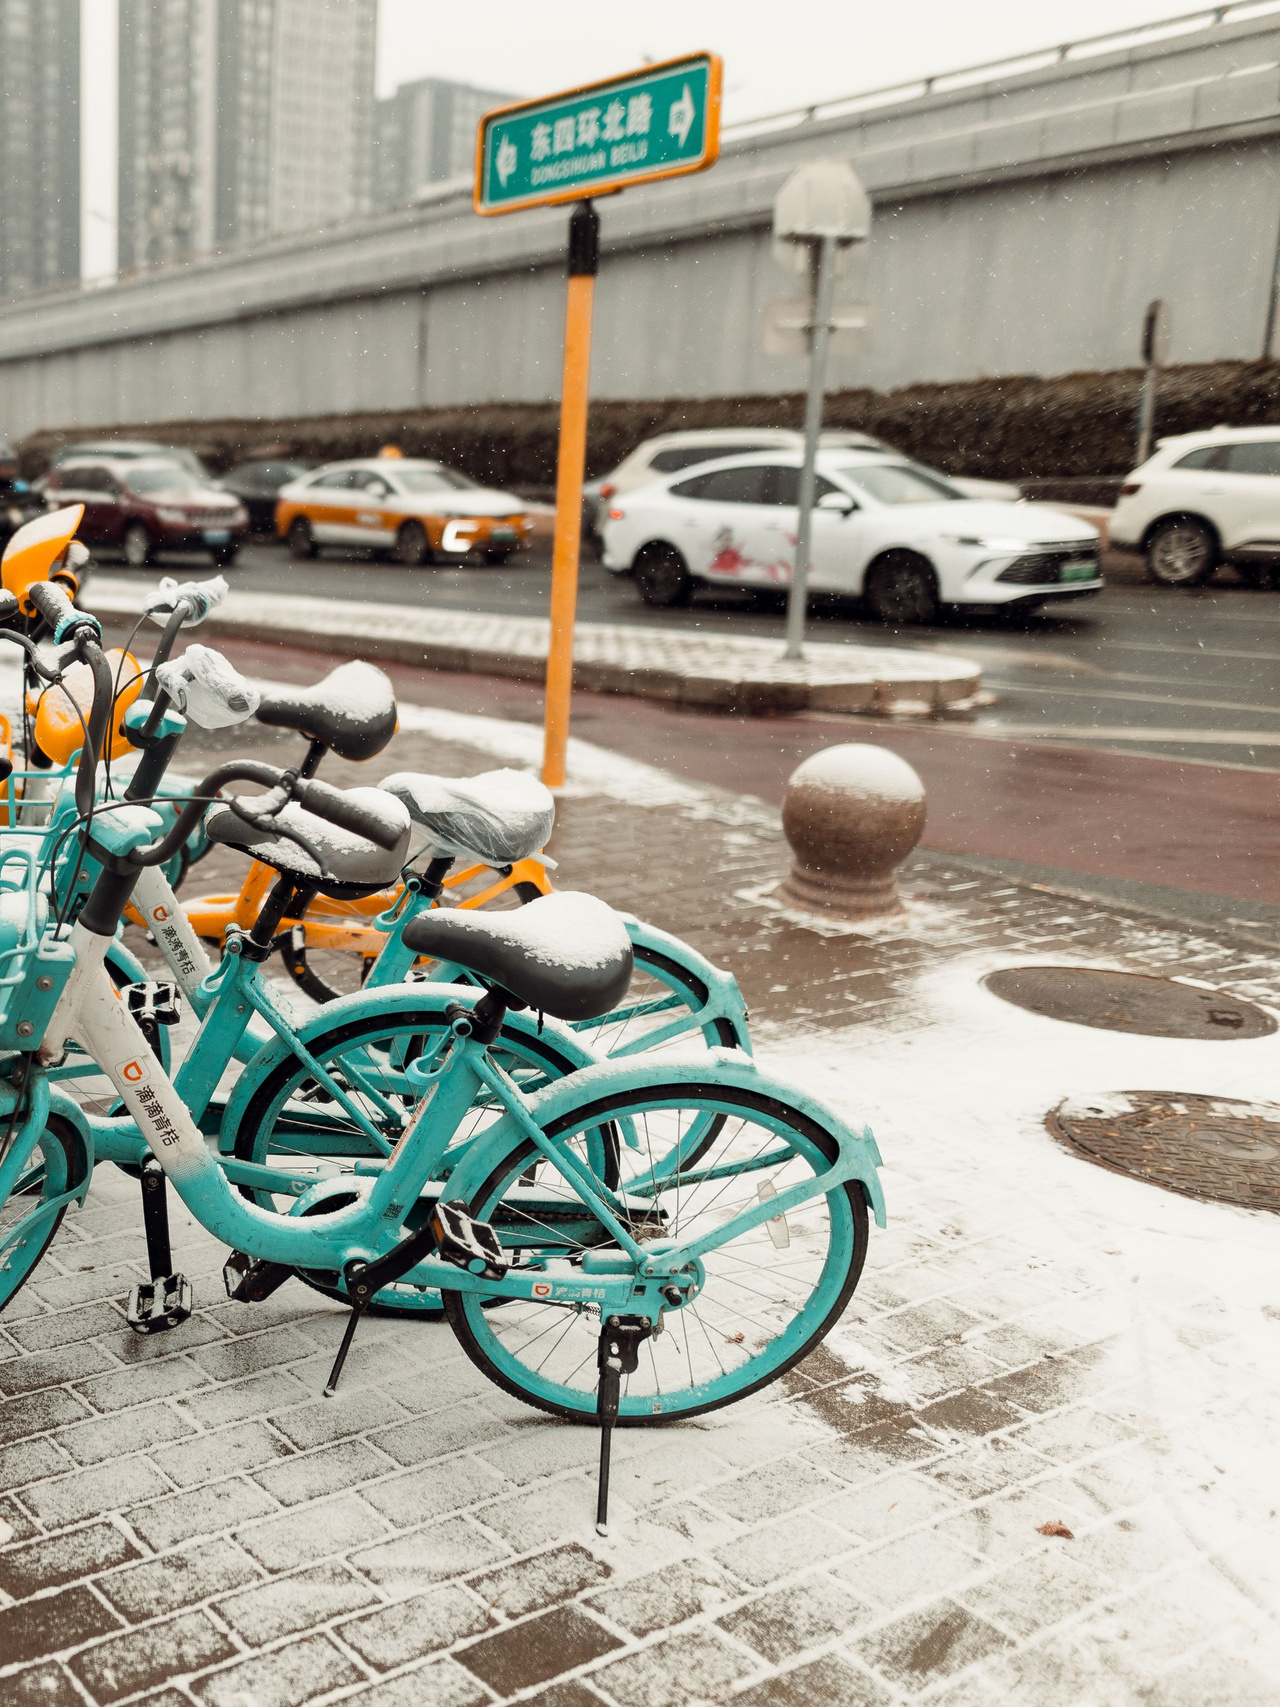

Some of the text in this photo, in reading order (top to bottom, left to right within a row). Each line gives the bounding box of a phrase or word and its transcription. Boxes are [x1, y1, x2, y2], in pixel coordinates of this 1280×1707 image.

[530, 92, 653, 161] 东四环北路
[531, 139, 649, 186] DONGSIHUAN BEILU
[134, 1085, 180, 1147] 滴滴青桔
